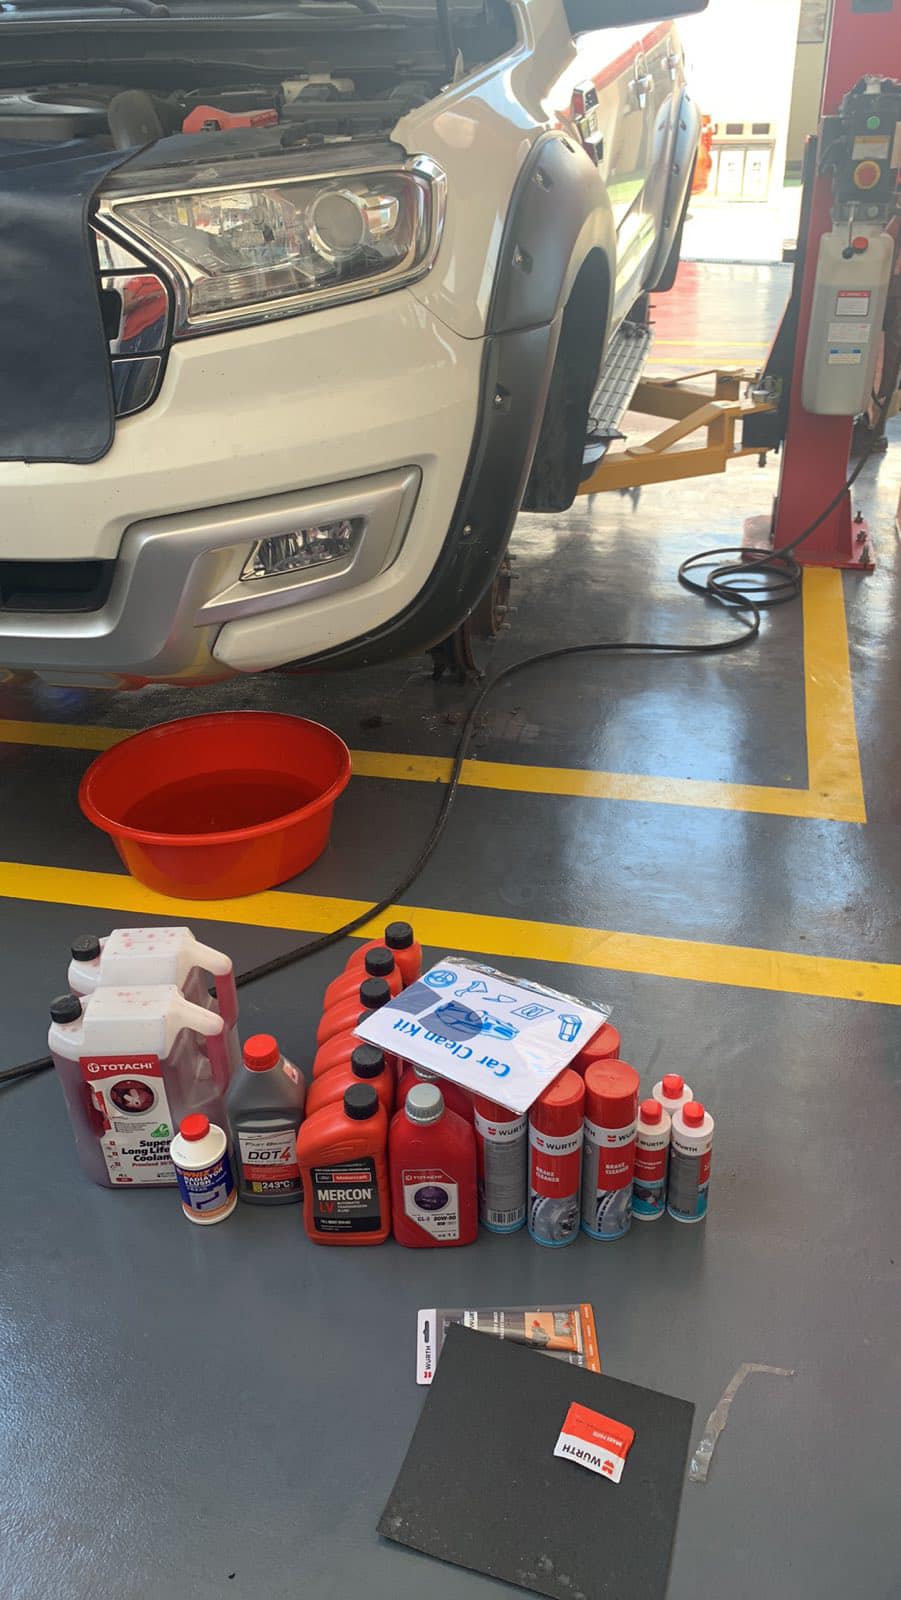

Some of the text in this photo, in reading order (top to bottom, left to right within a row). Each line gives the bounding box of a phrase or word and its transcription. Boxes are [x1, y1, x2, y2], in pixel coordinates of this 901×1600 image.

[393, 1018, 511, 1078] Car Clean Kit
[100, 1062, 153, 1071] TOTACHI
[139, 1139, 172, 1148] Super
[121, 1146, 170, 1156] Long Life
[133, 1154, 172, 1162] Coolan
[183, 1167, 223, 1182] RADIATOR
[317, 1188, 372, 1201] MERCON
[319, 1202, 335, 1214] LV
